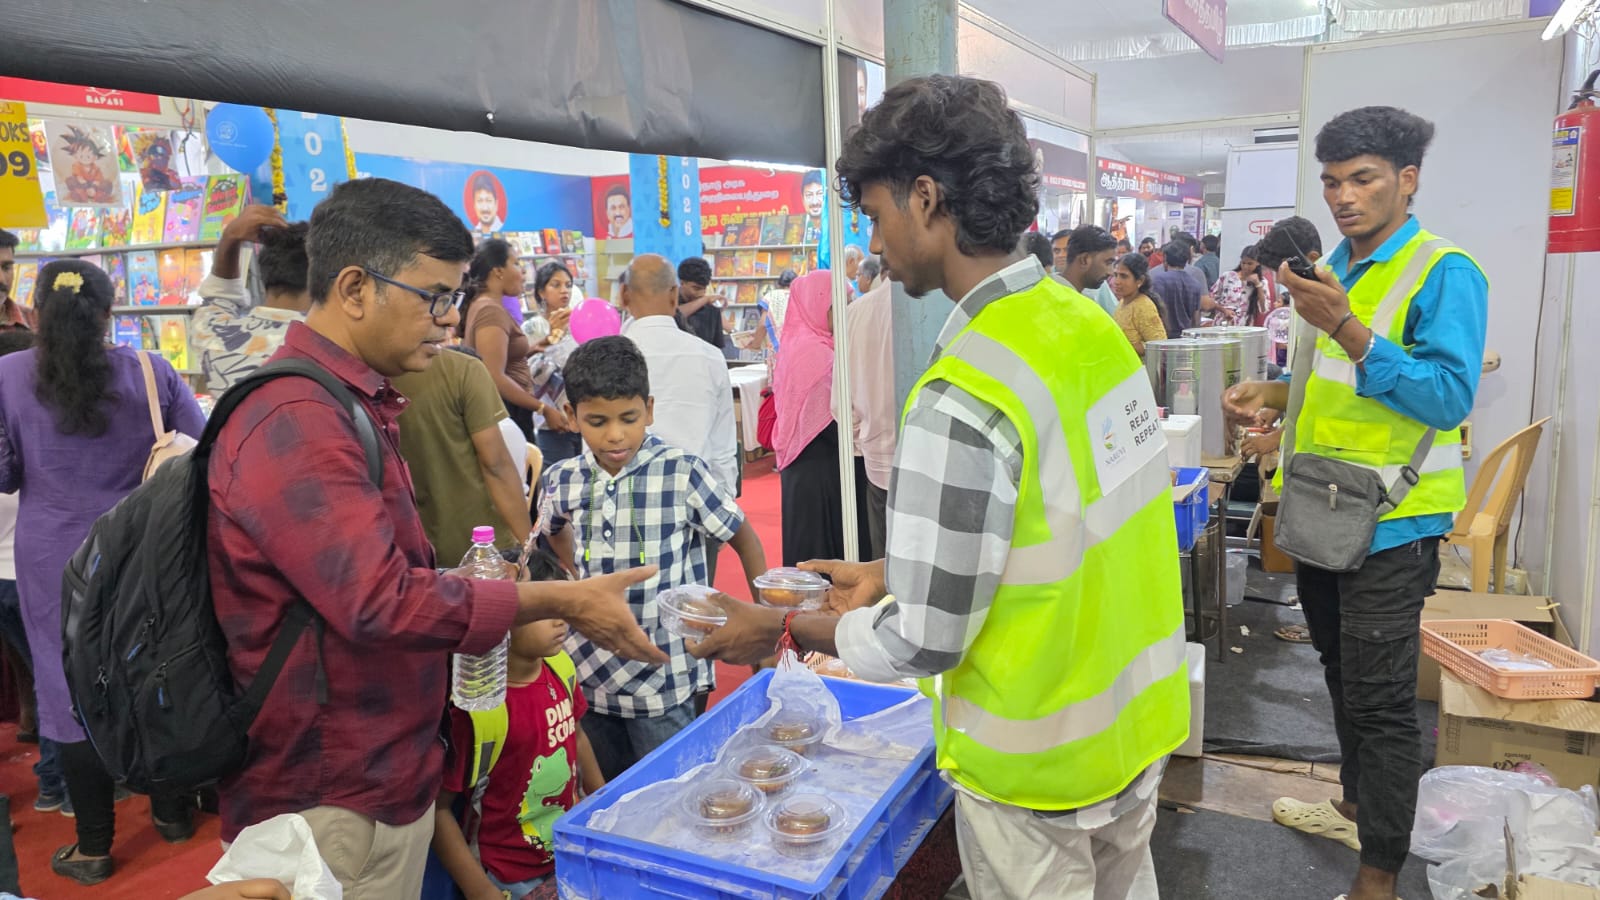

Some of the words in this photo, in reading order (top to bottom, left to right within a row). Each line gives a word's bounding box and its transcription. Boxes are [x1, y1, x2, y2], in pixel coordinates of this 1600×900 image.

[86, 95, 124, 106] BAPASI
[1125, 400, 1138, 416] SIP
[1129, 410, 1149, 432] READ
[1134, 418, 1159, 447] REPEAT
